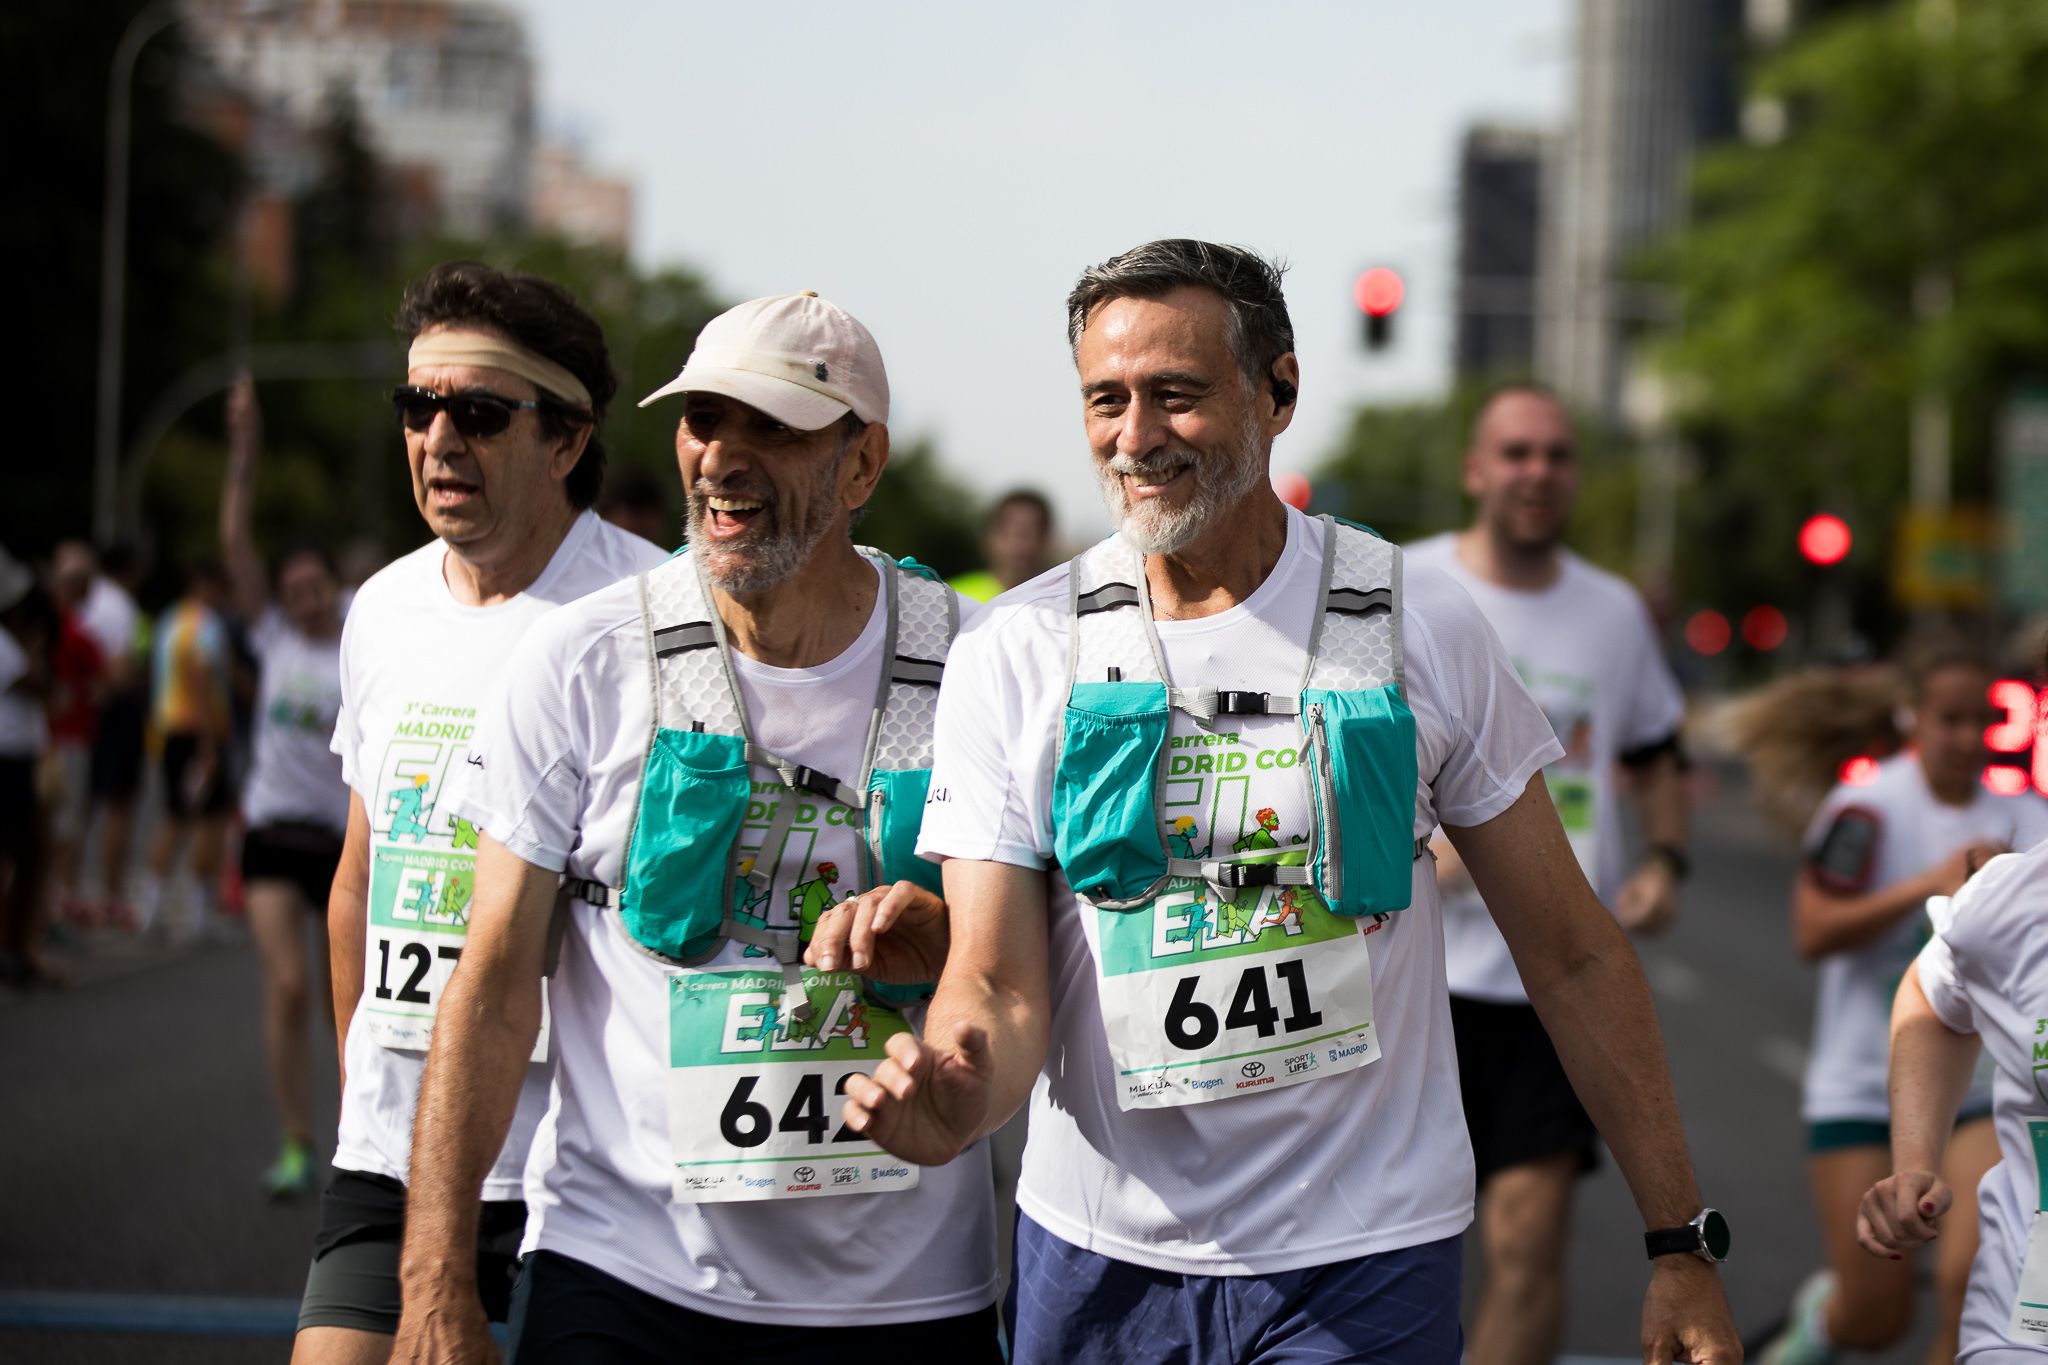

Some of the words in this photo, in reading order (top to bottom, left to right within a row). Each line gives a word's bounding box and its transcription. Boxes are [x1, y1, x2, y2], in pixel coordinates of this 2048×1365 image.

[421, 703, 477, 718] Carrera
[395, 720, 475, 741] MADRID
[1170, 732, 1240, 749] arrera
[1167, 752, 1248, 776] DRID
[1256, 748, 1302, 770] CO
[746, 801, 819, 824] DRD
[404, 854, 449, 870] MADRID
[1151, 884, 1305, 959] ELA
[731, 977, 786, 991] MADRI
[835, 976, 853, 986] LA
[1164, 959, 1323, 1051] 641
[719, 989, 870, 1054] ELA
[1338, 1043, 1368, 1059] MADRID
[1284, 1053, 1309, 1066] SPORT
[1289, 1061, 1309, 1073] LIFE
[1129, 1081, 1172, 1094] MUKUA
[1192, 1078, 1223, 1089] Biogen
[832, 1167, 855, 1175] SPORT
[879, 1168, 908, 1178] MADRID
[835, 1175, 852, 1183] LIFE
